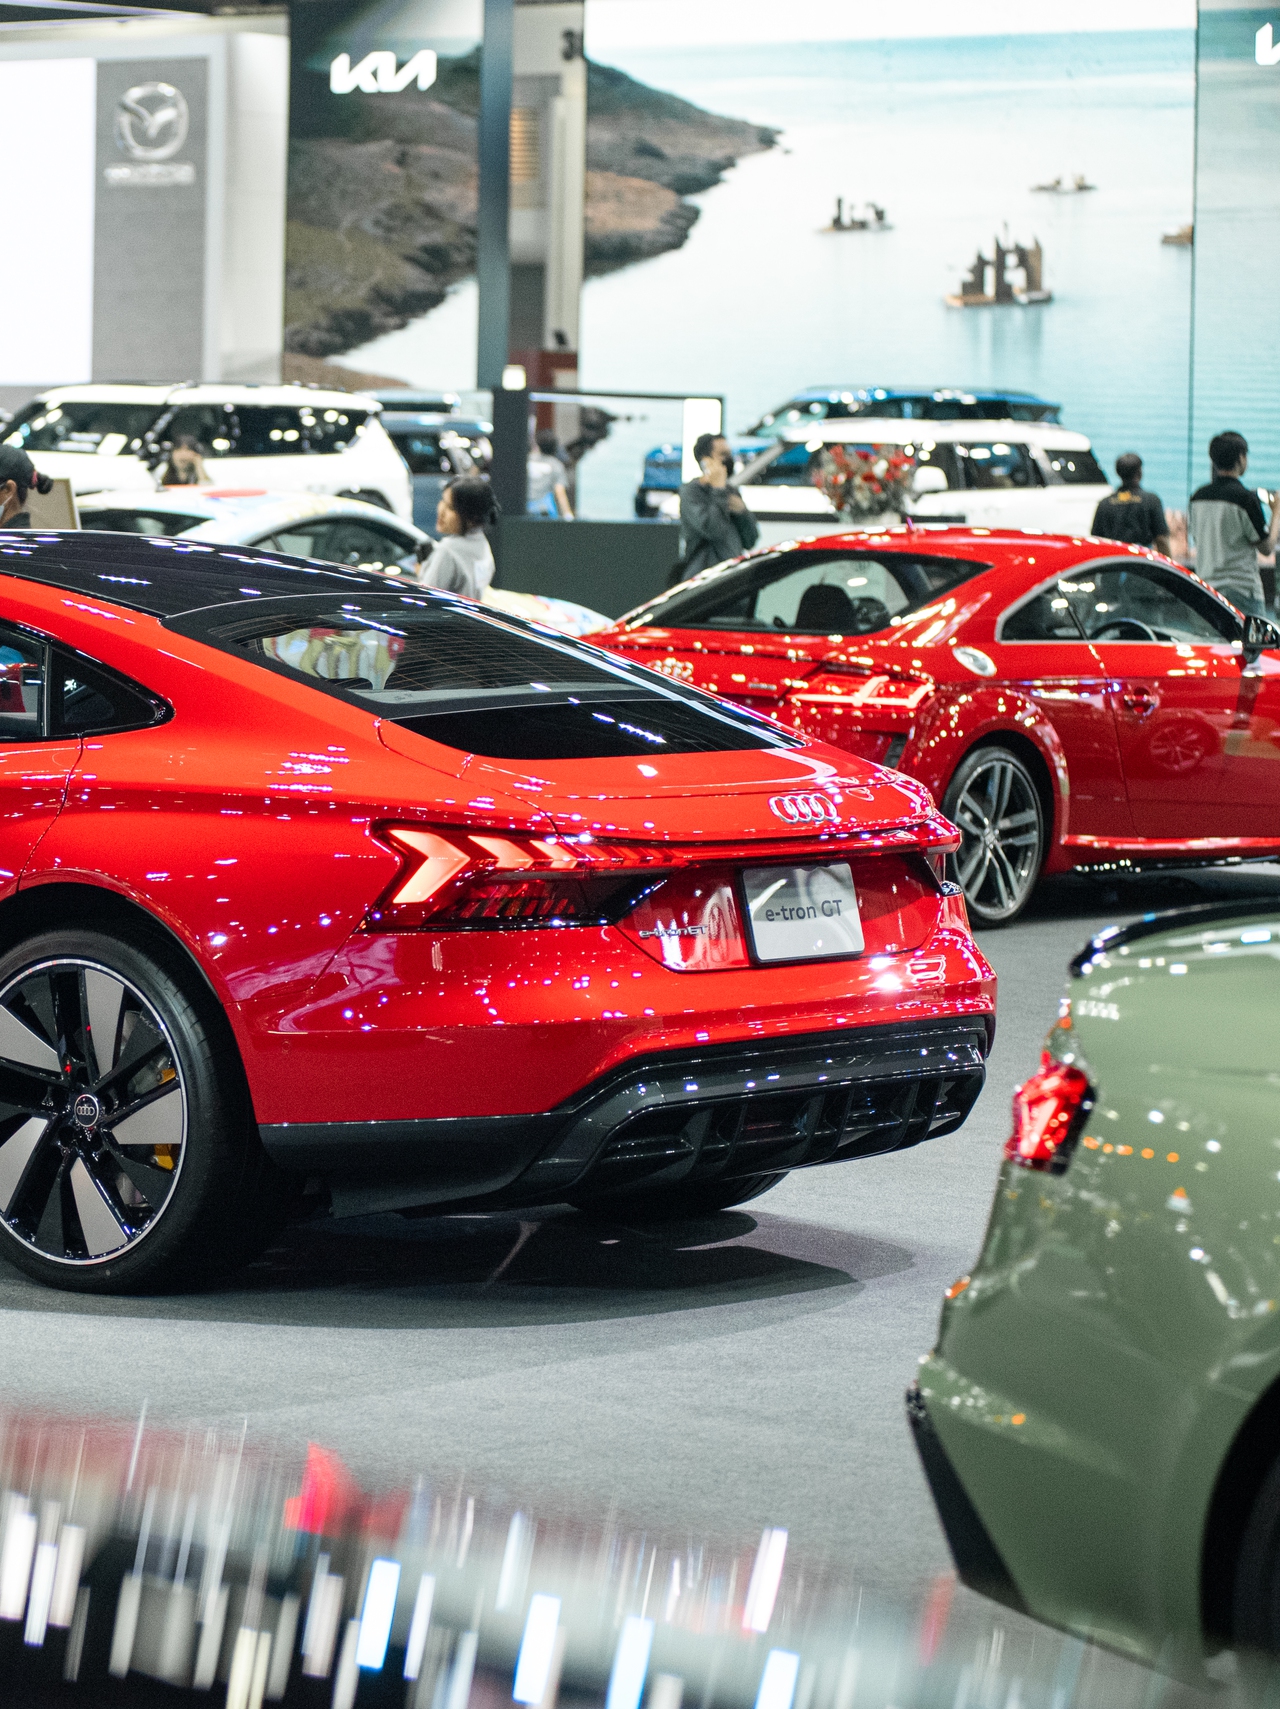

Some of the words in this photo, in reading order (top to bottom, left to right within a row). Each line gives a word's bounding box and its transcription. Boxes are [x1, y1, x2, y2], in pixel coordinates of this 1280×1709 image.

[330, 50, 437, 94] KIA
[765, 905, 817, 921] e-tron
[821, 899, 842, 918] GT
